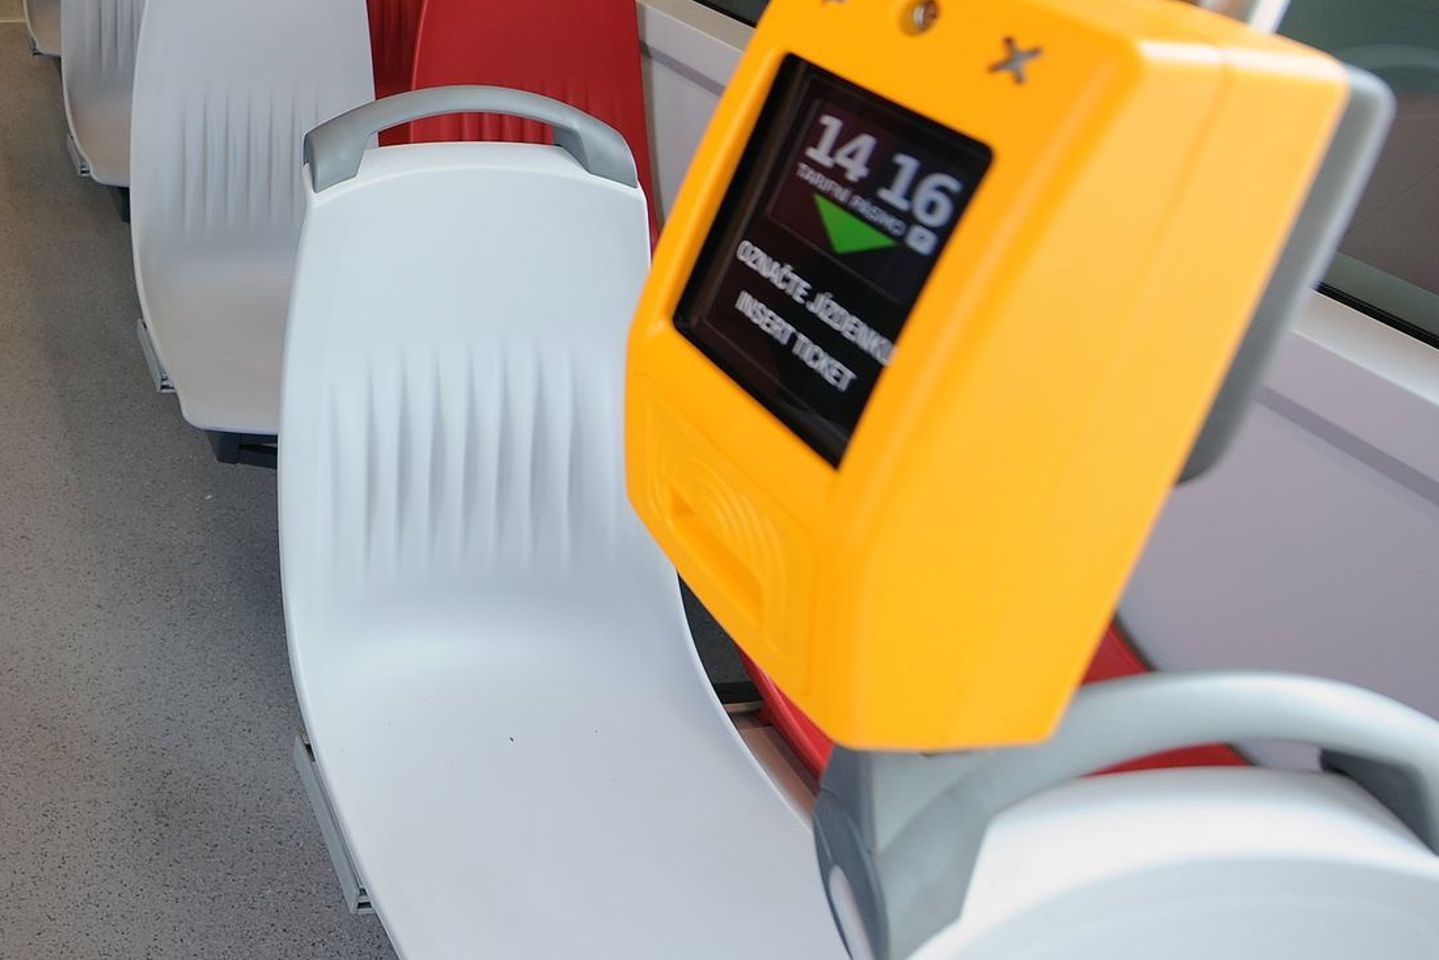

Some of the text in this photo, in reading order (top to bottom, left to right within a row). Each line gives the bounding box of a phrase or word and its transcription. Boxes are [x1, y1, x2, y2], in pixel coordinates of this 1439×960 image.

[736, 240, 813, 305] OZNAČTE
[735, 290, 858, 392] INSERT TICKET
